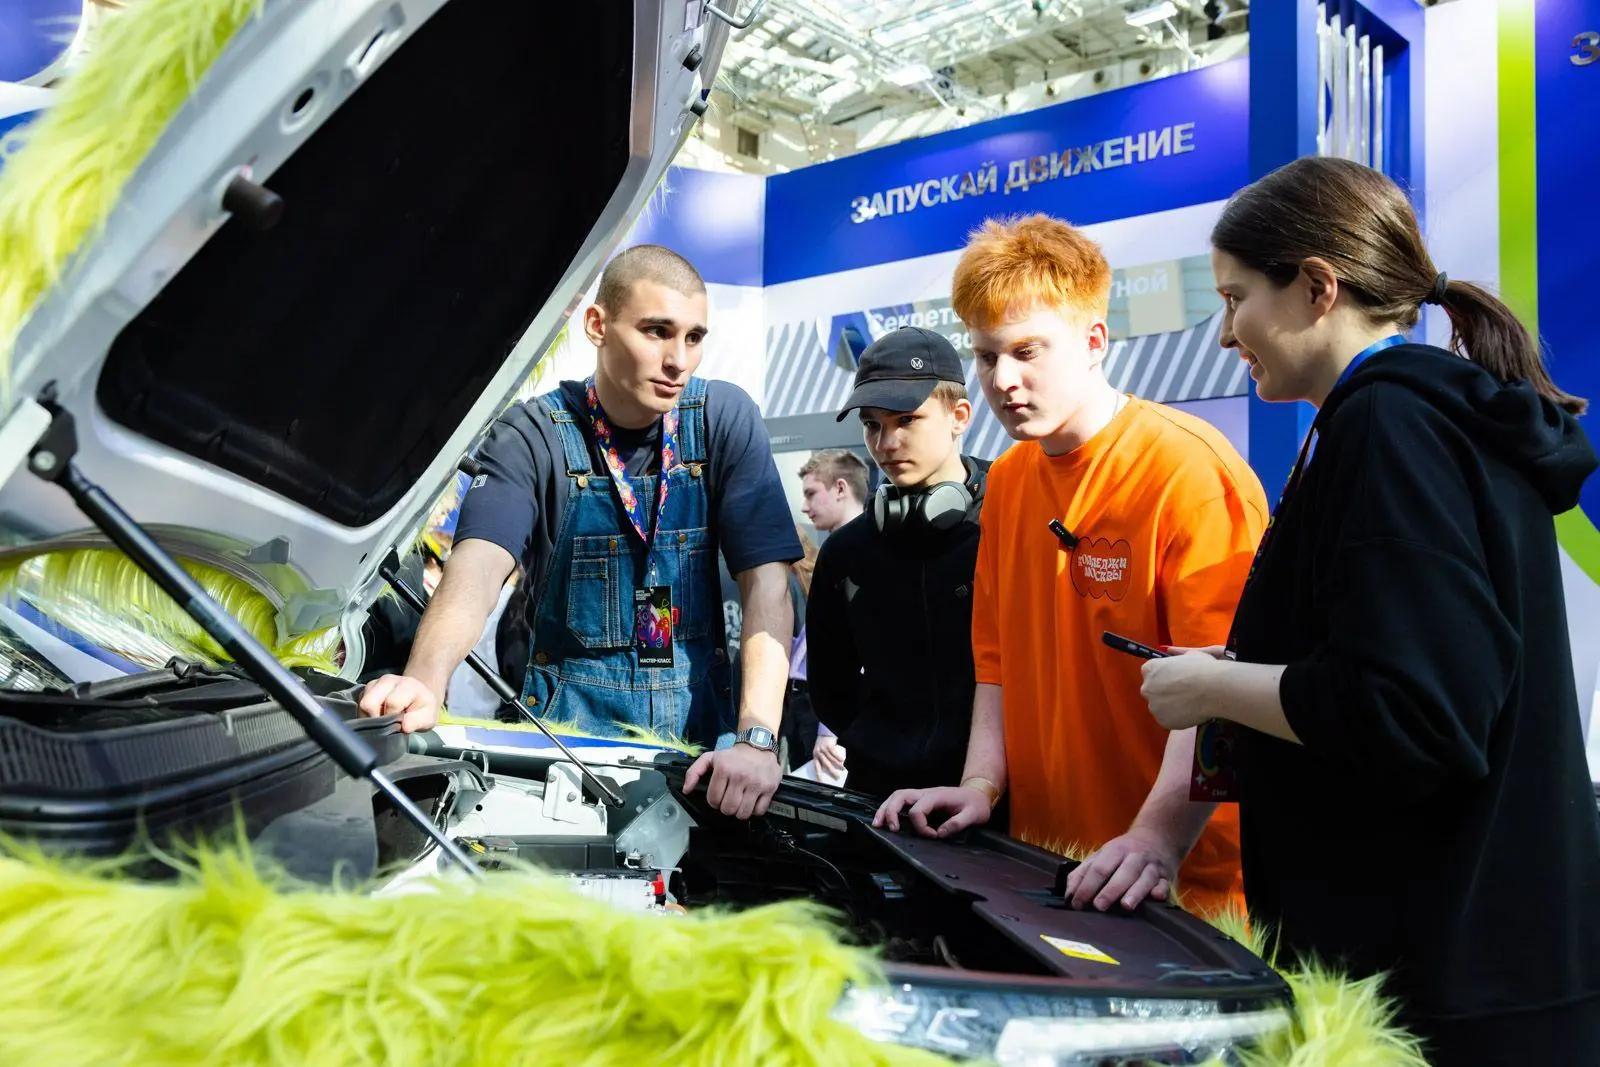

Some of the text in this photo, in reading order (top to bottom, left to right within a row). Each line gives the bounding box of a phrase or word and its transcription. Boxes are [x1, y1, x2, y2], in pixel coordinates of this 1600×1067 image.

[851, 122, 1195, 224] ЗАПУСКАЙ ДВИЖЕНИЕ
[1111, 267, 1168, 299] ной
